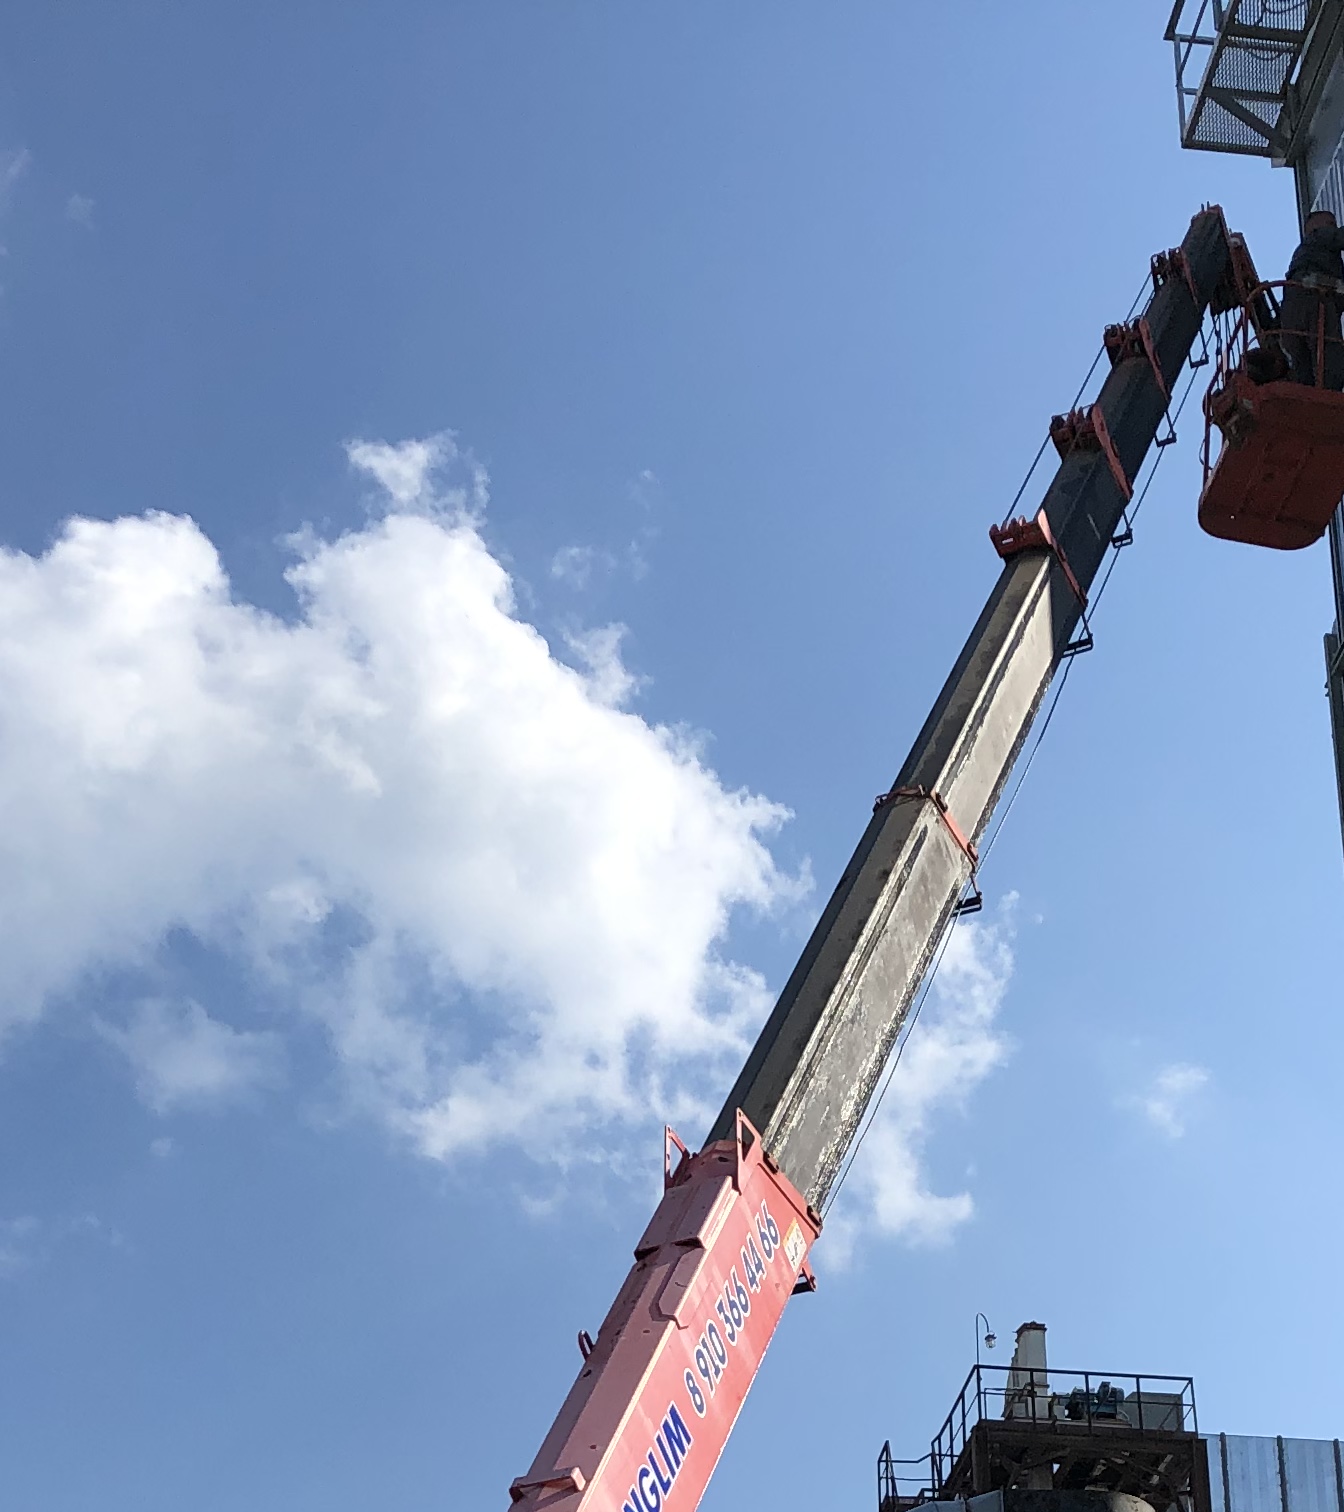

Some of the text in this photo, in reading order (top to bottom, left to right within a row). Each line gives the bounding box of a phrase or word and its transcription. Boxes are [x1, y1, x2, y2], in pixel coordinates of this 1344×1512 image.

[740, 1231, 768, 1294] 44
[755, 1199, 780, 1264] 66
[714, 1264, 752, 1347] 366
[694, 1318, 728, 1398] 910
[683, 1367, 706, 1419] 8
